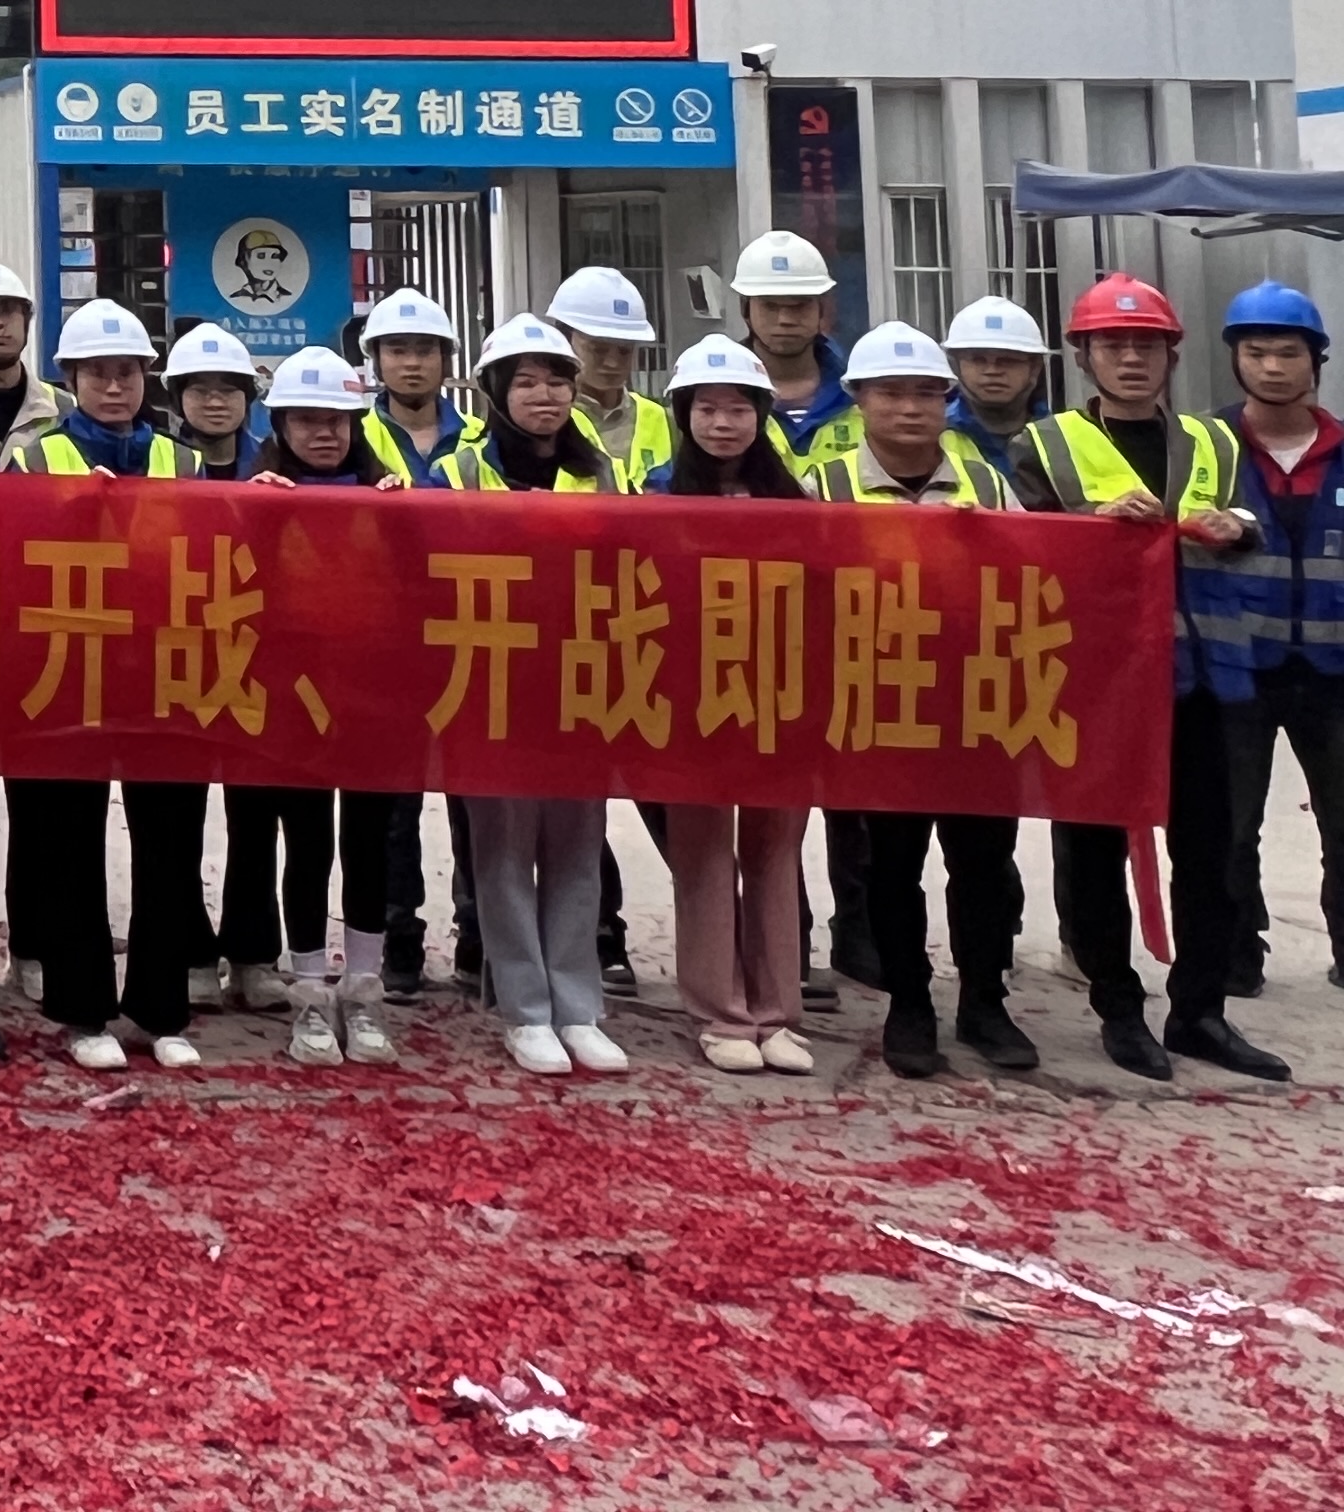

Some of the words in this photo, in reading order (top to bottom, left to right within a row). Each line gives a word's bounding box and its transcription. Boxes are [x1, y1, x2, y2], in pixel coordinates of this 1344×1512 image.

[185, 88, 585, 140] 员工实名制通道
